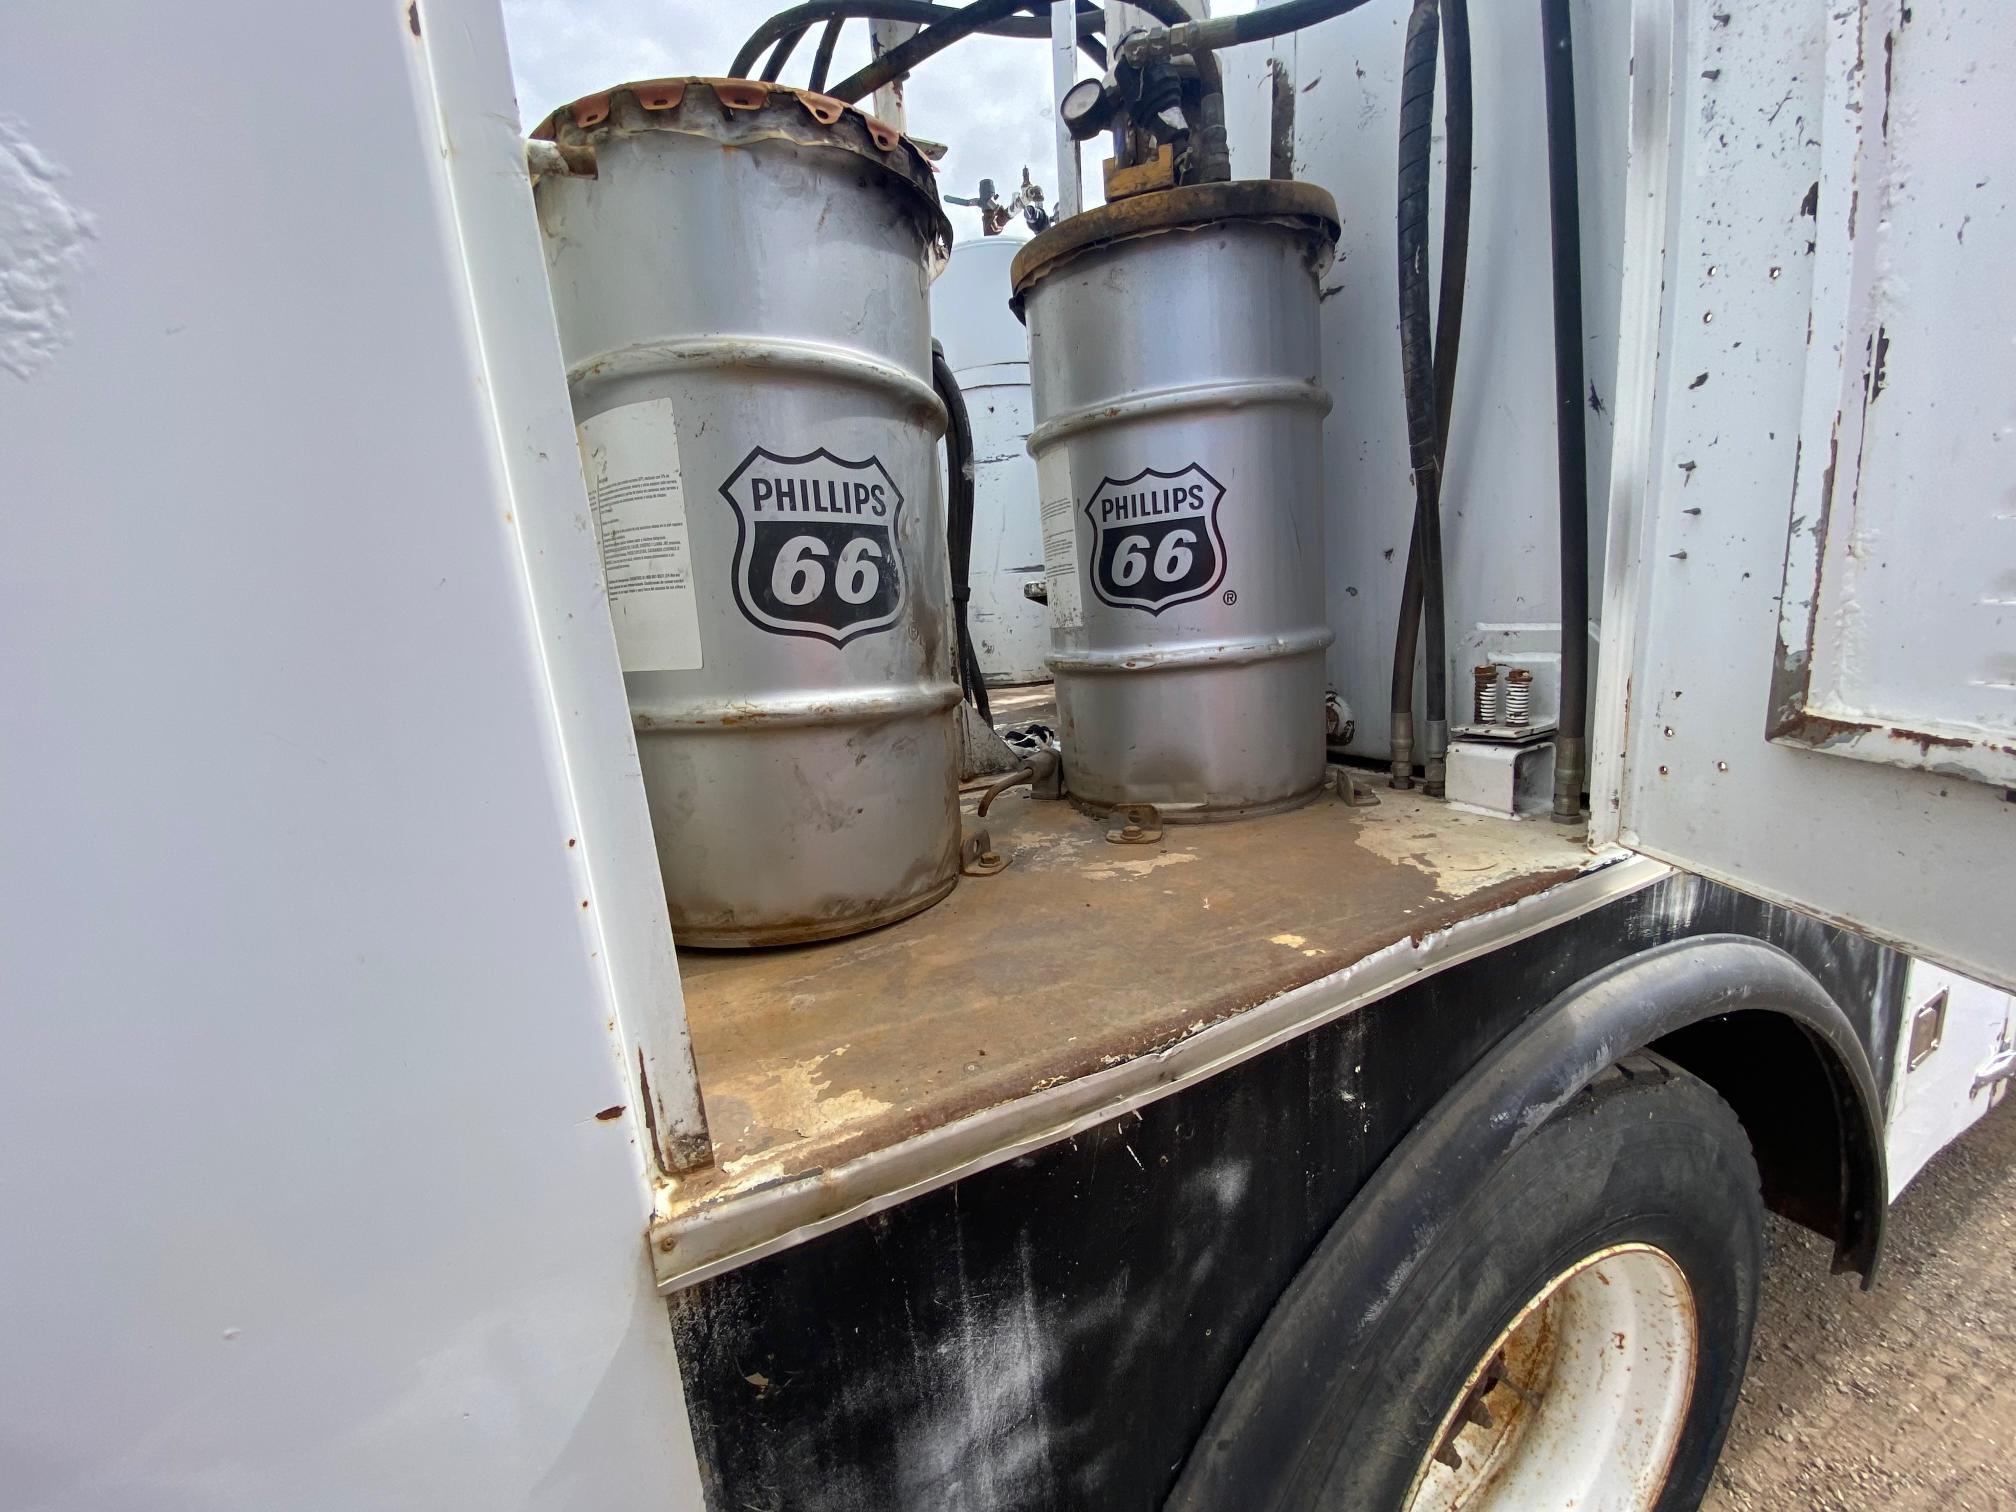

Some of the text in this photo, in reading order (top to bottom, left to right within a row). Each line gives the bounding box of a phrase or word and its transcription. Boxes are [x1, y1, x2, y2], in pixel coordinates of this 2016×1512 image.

[751, 478, 887, 517] PHILLIPS
[1101, 484, 1204, 522] PHILLIPS
[771, 535, 882, 605] 66
[1111, 529, 1197, 587] 66
